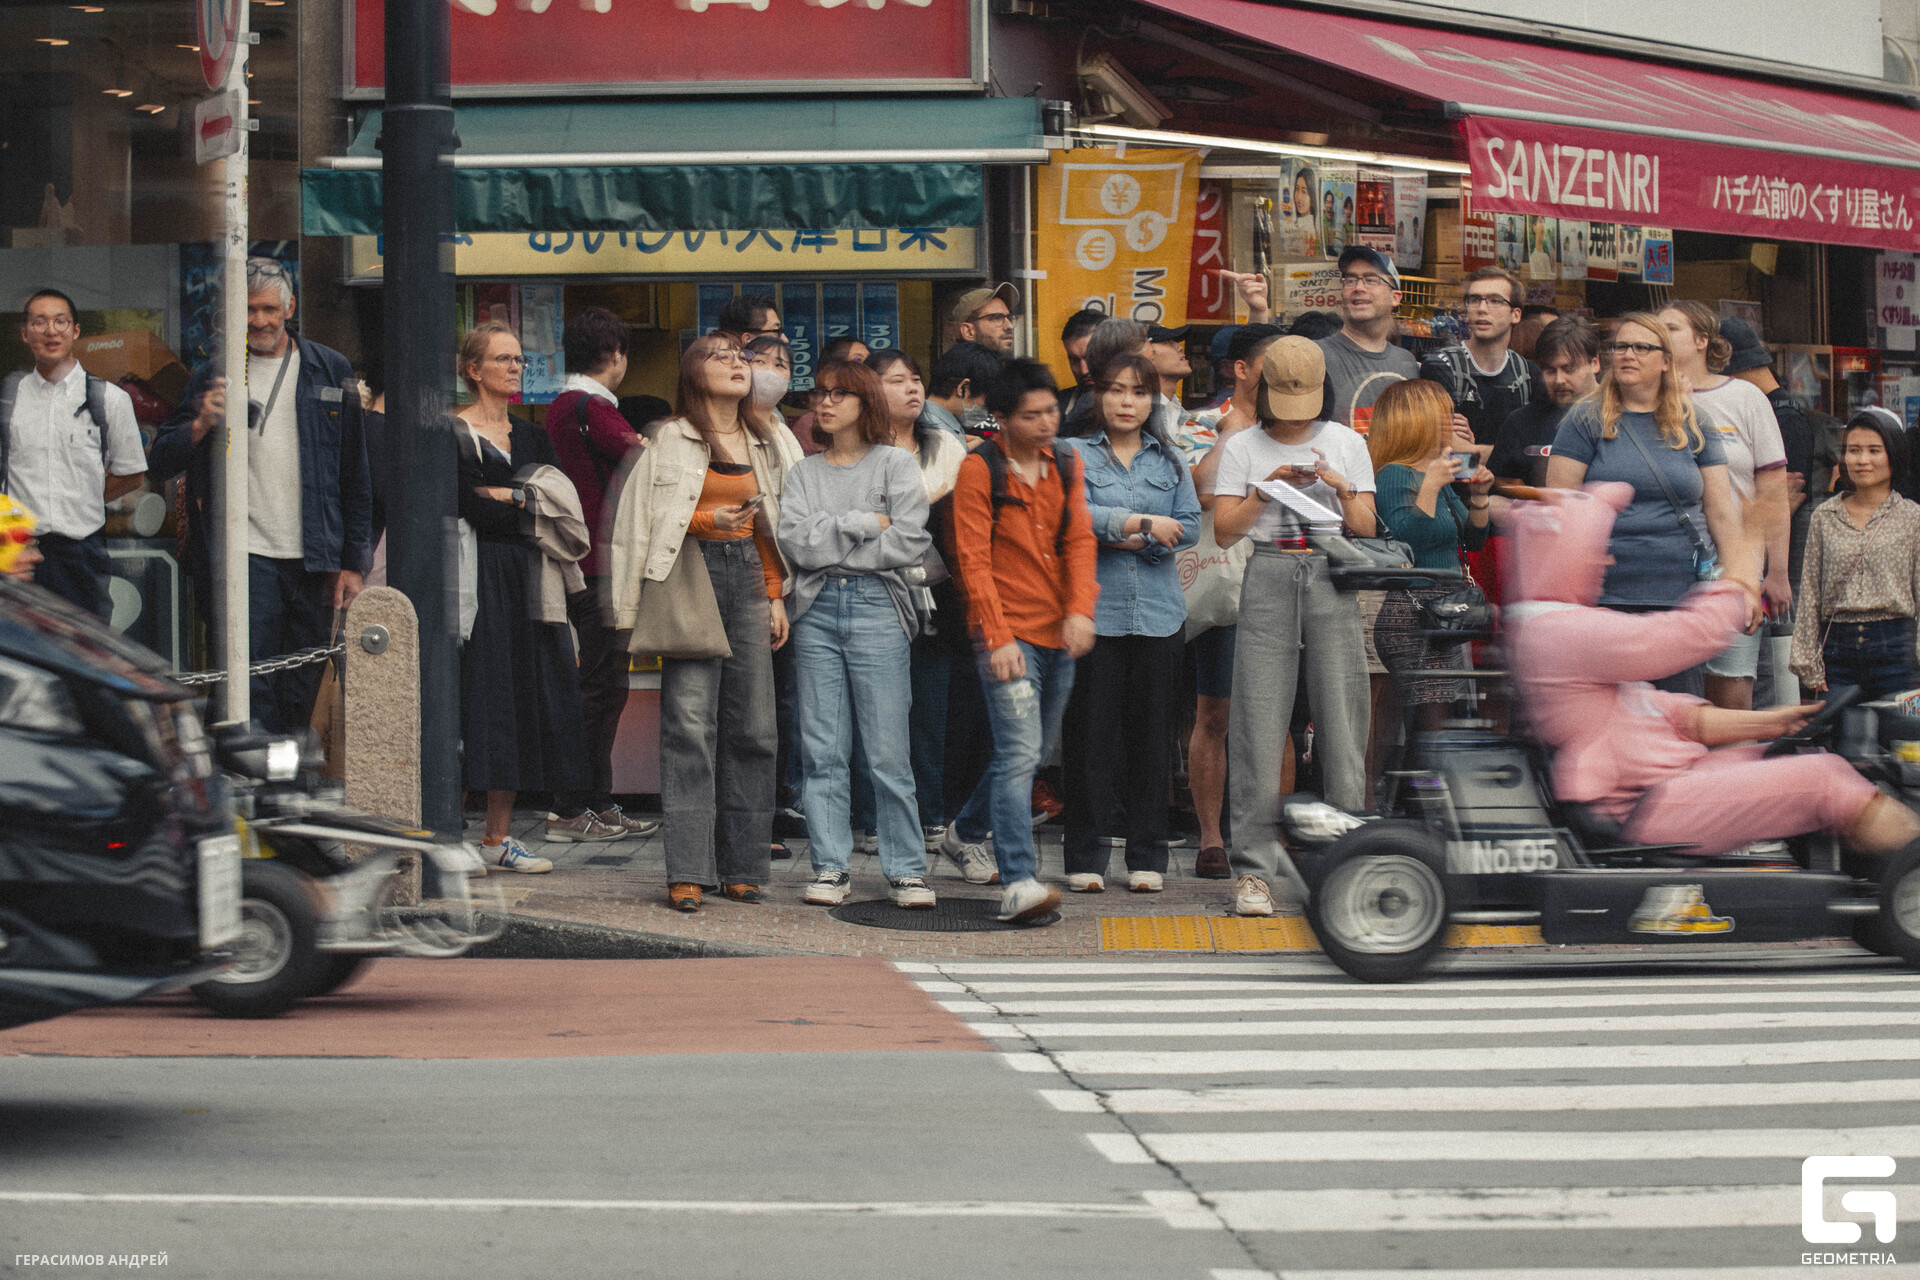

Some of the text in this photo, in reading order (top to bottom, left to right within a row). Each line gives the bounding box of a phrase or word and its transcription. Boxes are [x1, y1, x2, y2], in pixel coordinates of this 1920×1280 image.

[1487, 137, 1659, 214] SANZENRI
[1713, 175, 1913, 231] ハチ公前のくすり屋さん
